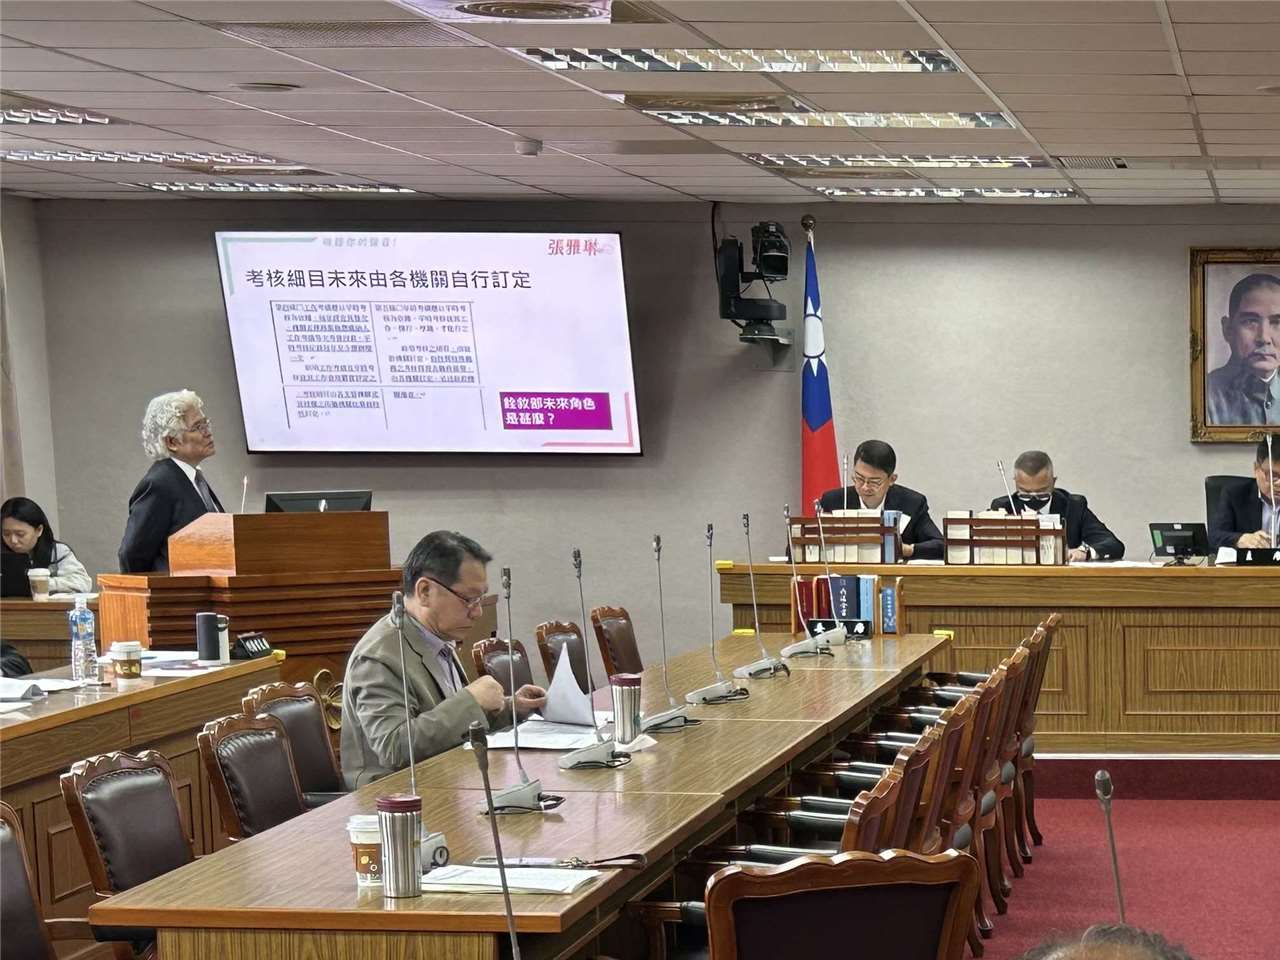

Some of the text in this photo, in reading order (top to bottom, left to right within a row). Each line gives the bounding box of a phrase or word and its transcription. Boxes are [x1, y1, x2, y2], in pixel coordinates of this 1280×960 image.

[548, 238, 598, 256] 張雅琳
[245, 268, 533, 290] 考核細目未來由各機關自行訂定
